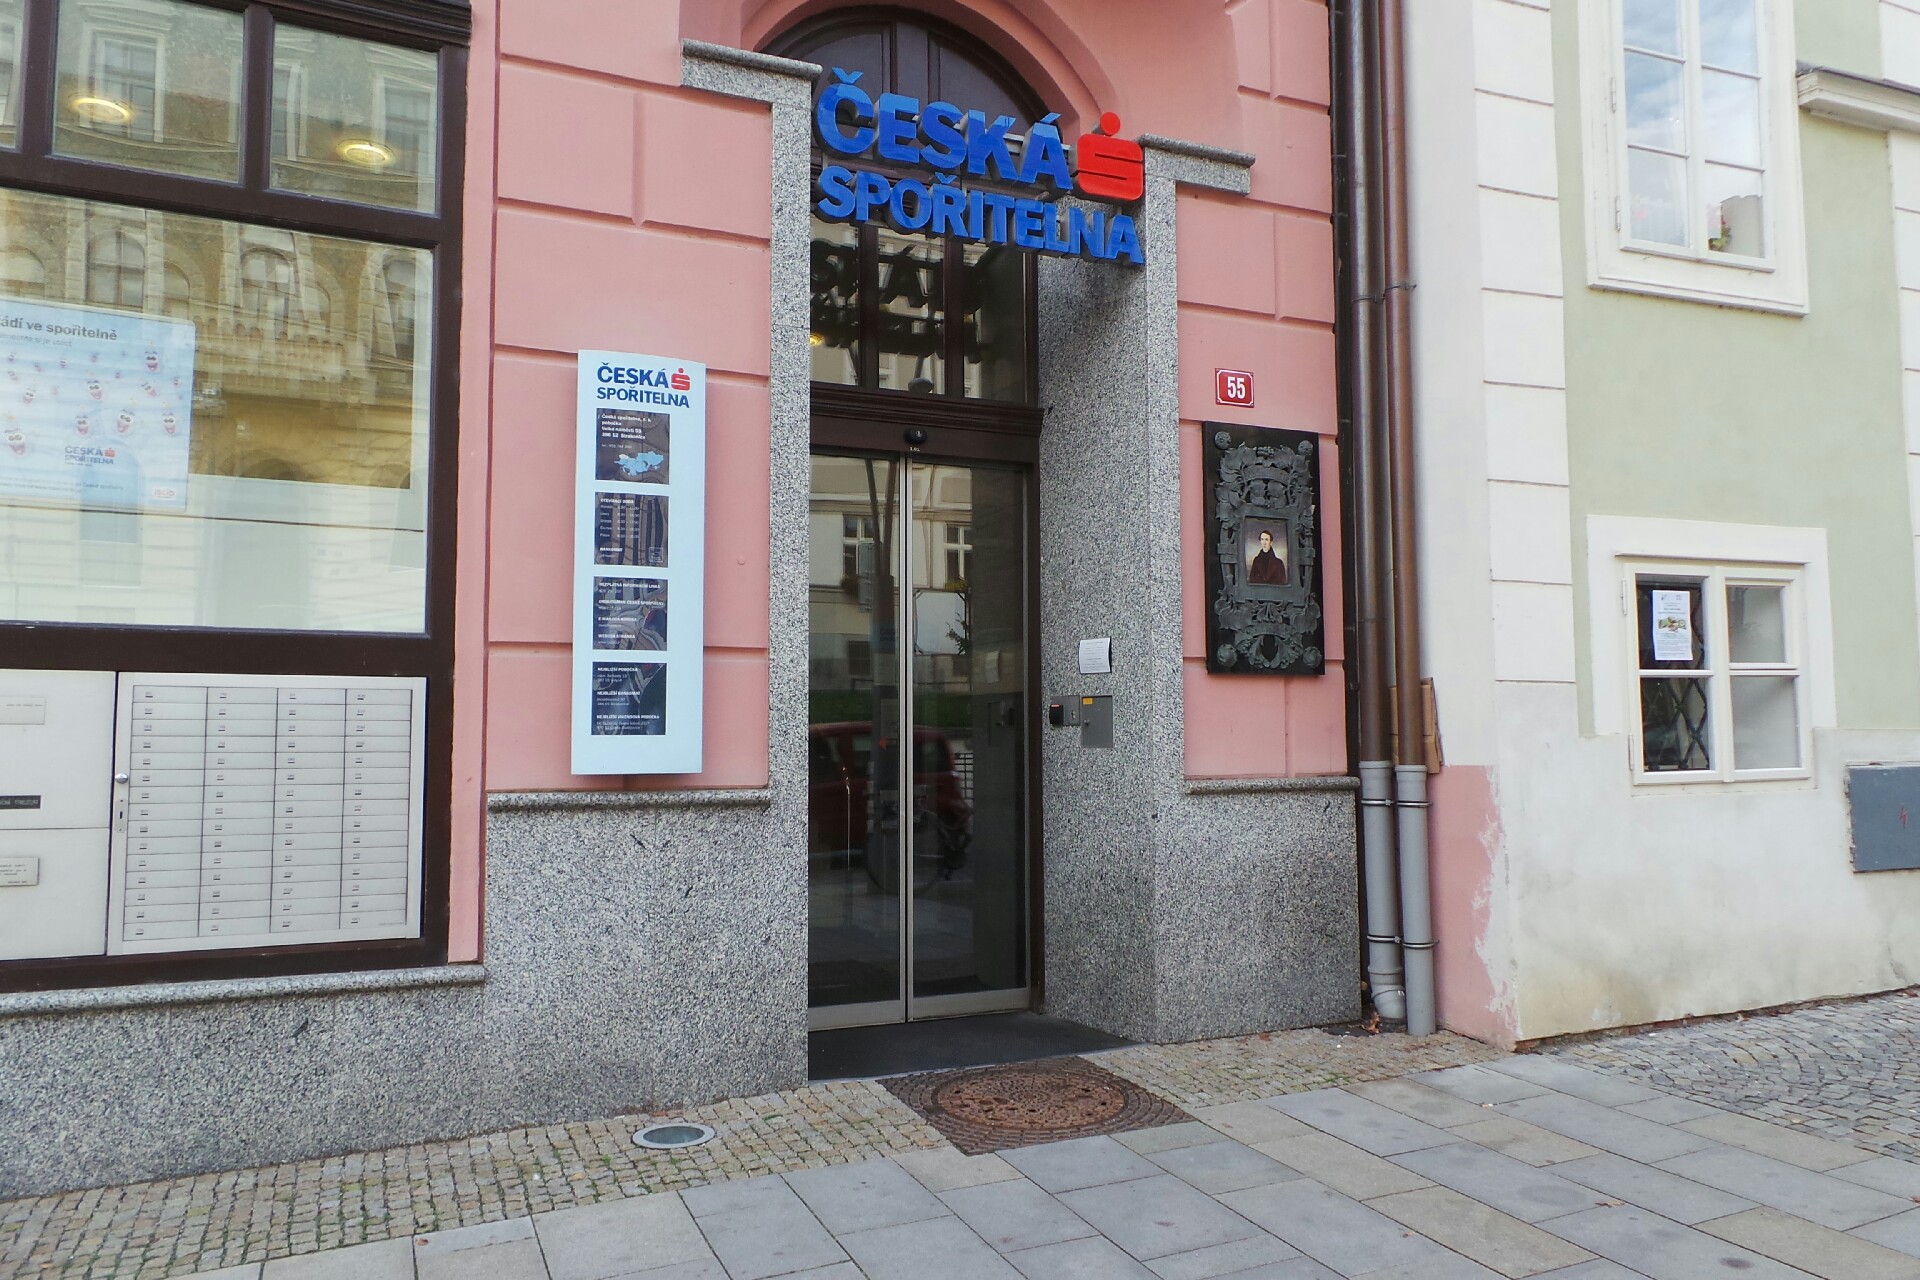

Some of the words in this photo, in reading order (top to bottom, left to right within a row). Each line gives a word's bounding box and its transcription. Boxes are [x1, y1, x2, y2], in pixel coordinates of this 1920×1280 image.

[816, 67, 1073, 190] ČESKÁ
[817, 166, 1146, 265] SPOŘITELNA
[0, 315, 23, 329] ádí
[27, 321, 42, 331] ve
[46, 324, 118, 341] spořitelně
[597, 362, 669, 388] ČESKÁ
[1227, 376, 1246, 399] 55
[597, 386, 690, 408] SPOŘITELNA
